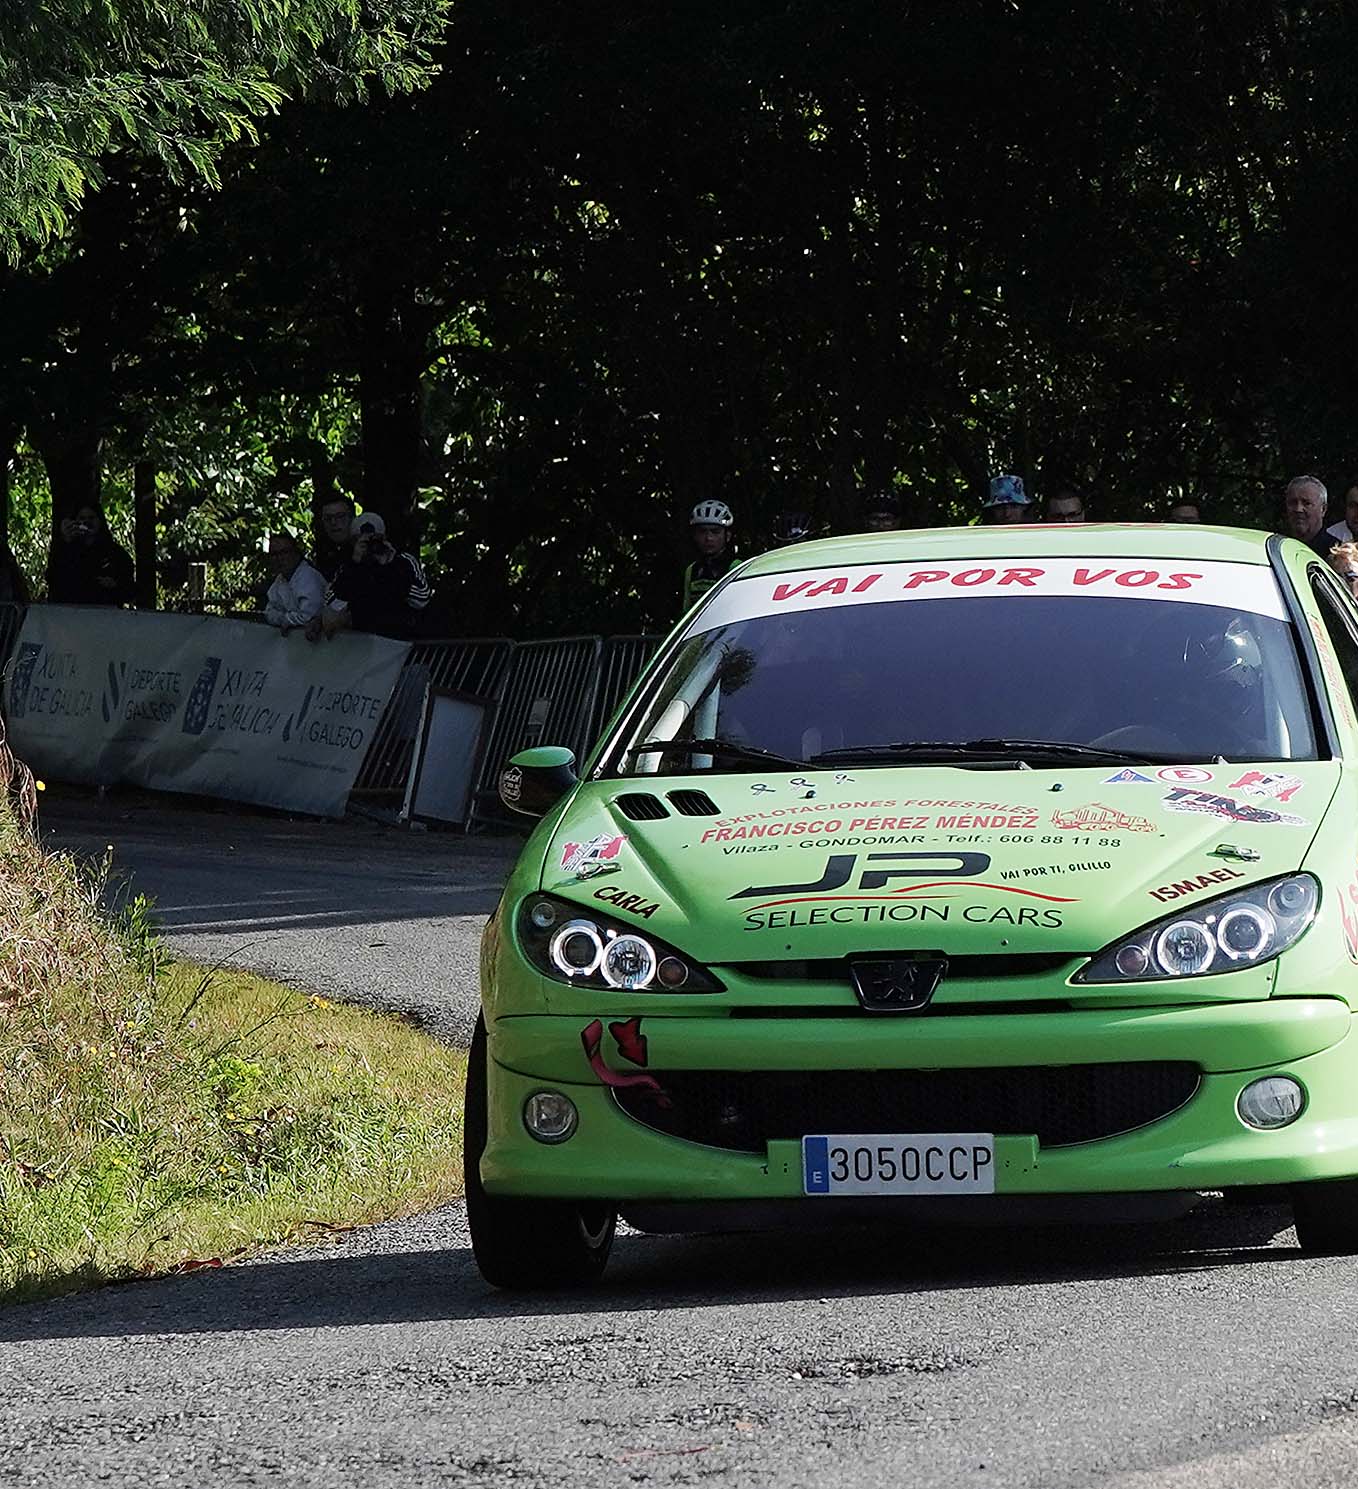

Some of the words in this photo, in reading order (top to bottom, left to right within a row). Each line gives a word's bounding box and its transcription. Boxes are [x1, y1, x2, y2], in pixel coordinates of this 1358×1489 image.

[772, 573, 884, 602] VAI
[903, 567, 1046, 590] POR
[1072, 567, 1204, 590] VOS
[129, 668, 182, 694] DEPORTE
[312, 690, 381, 720] PORTE
[308, 721, 364, 750] GALEGO
[1173, 770, 1199, 779] E
[701, 819, 842, 844] FRANCISCO
[850, 815, 930, 832] PÉREZ
[935, 812, 1039, 829] MÉNDEZ
[715, 800, 896, 827] EXPLOTACIONES
[904, 800, 1039, 814] FORESTALES
[722, 844, 779, 856] Vilaza
[800, 835, 925, 848] GONDOMAR
[1000, 834, 1034, 844] 606
[1040, 835, 1064, 845] 88
[1073, 837, 1090, 846] 11
[1098, 838, 1121, 847] 88
[727, 851, 992, 900] JP
[1000, 869, 1021, 880] VAI
[1024, 867, 1047, 877] POR
[1049, 865, 1066, 874] TI,
[1148, 866, 1247, 904] ISMAEL
[593, 886, 660, 919] CARLA
[744, 905, 950, 931] SELECTION
[962, 905, 1064, 929] CARS
[812, 1171, 823, 1184] E
[829, 1146, 992, 1182] 3050CCP
